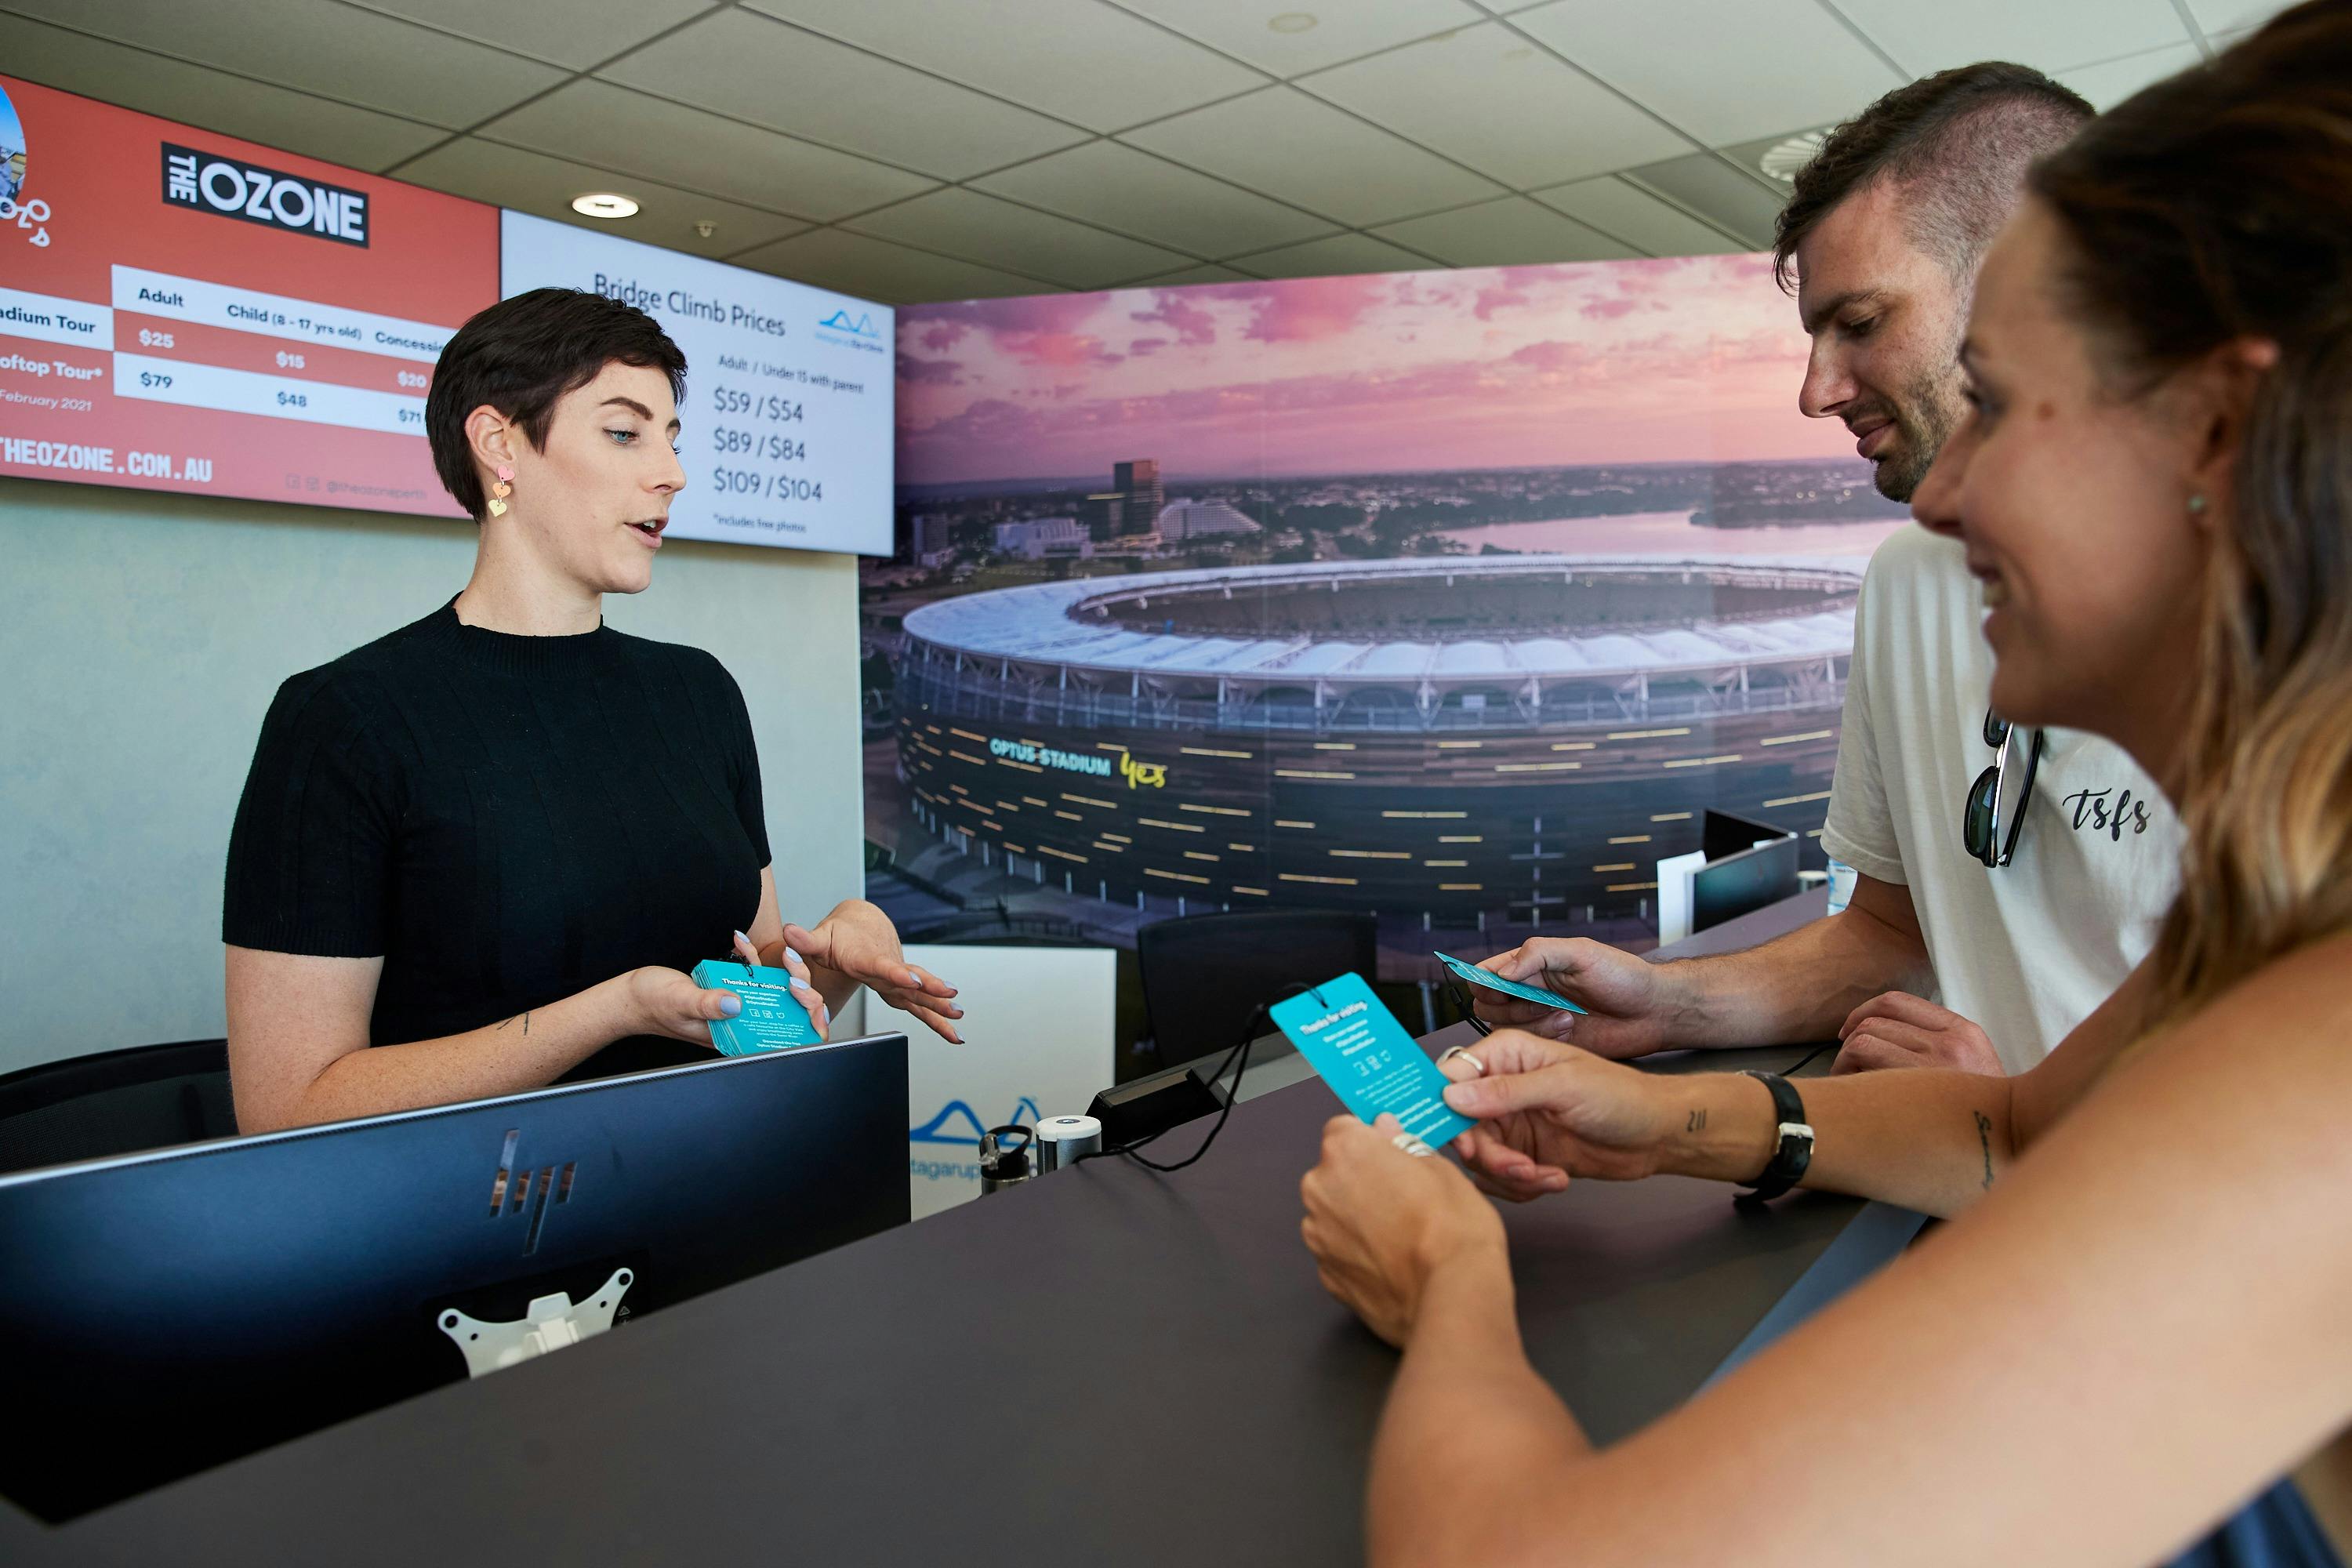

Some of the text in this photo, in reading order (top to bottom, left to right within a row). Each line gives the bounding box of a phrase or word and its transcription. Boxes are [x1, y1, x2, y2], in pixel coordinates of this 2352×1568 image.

[168, 154, 365, 241] THE OZONE
[139, 288, 184, 307] Adult
[594, 273, 786, 336] Bridge Climb Prices
[56, 314, 96, 333] Tour
[227, 304, 268, 322] Child
[272, 314, 285, 326] (8
[299, 318, 311, 330] 17
[314, 324, 334, 336] yrs
[339, 327, 362, 341] old)
[139, 328, 174, 349] $25
[276, 350, 306, 369] $15
[718, 354, 748, 371] Adult
[763, 363, 795, 379] Under
[797, 369, 807, 383] 15
[810, 374, 829, 387] with
[833, 379, 863, 393] parent
[140, 372, 173, 390] $79
[397, 370, 427, 388] $20
[60, 397, 93, 412] 2021
[277, 391, 307, 408] $48
[713, 385, 804, 423] $59 / $54
[398, 408, 422, 423] $71
[713, 425, 806, 462] $89 / $84
[713, 464, 822, 503] $109 / $104
[989, 737, 1111, 777] OPTUS STADIUM
[2062, 787, 2151, 842] tsfs
[760, 983, 788, 992] visiting.
[489, 1128, 578, 1257] hp
